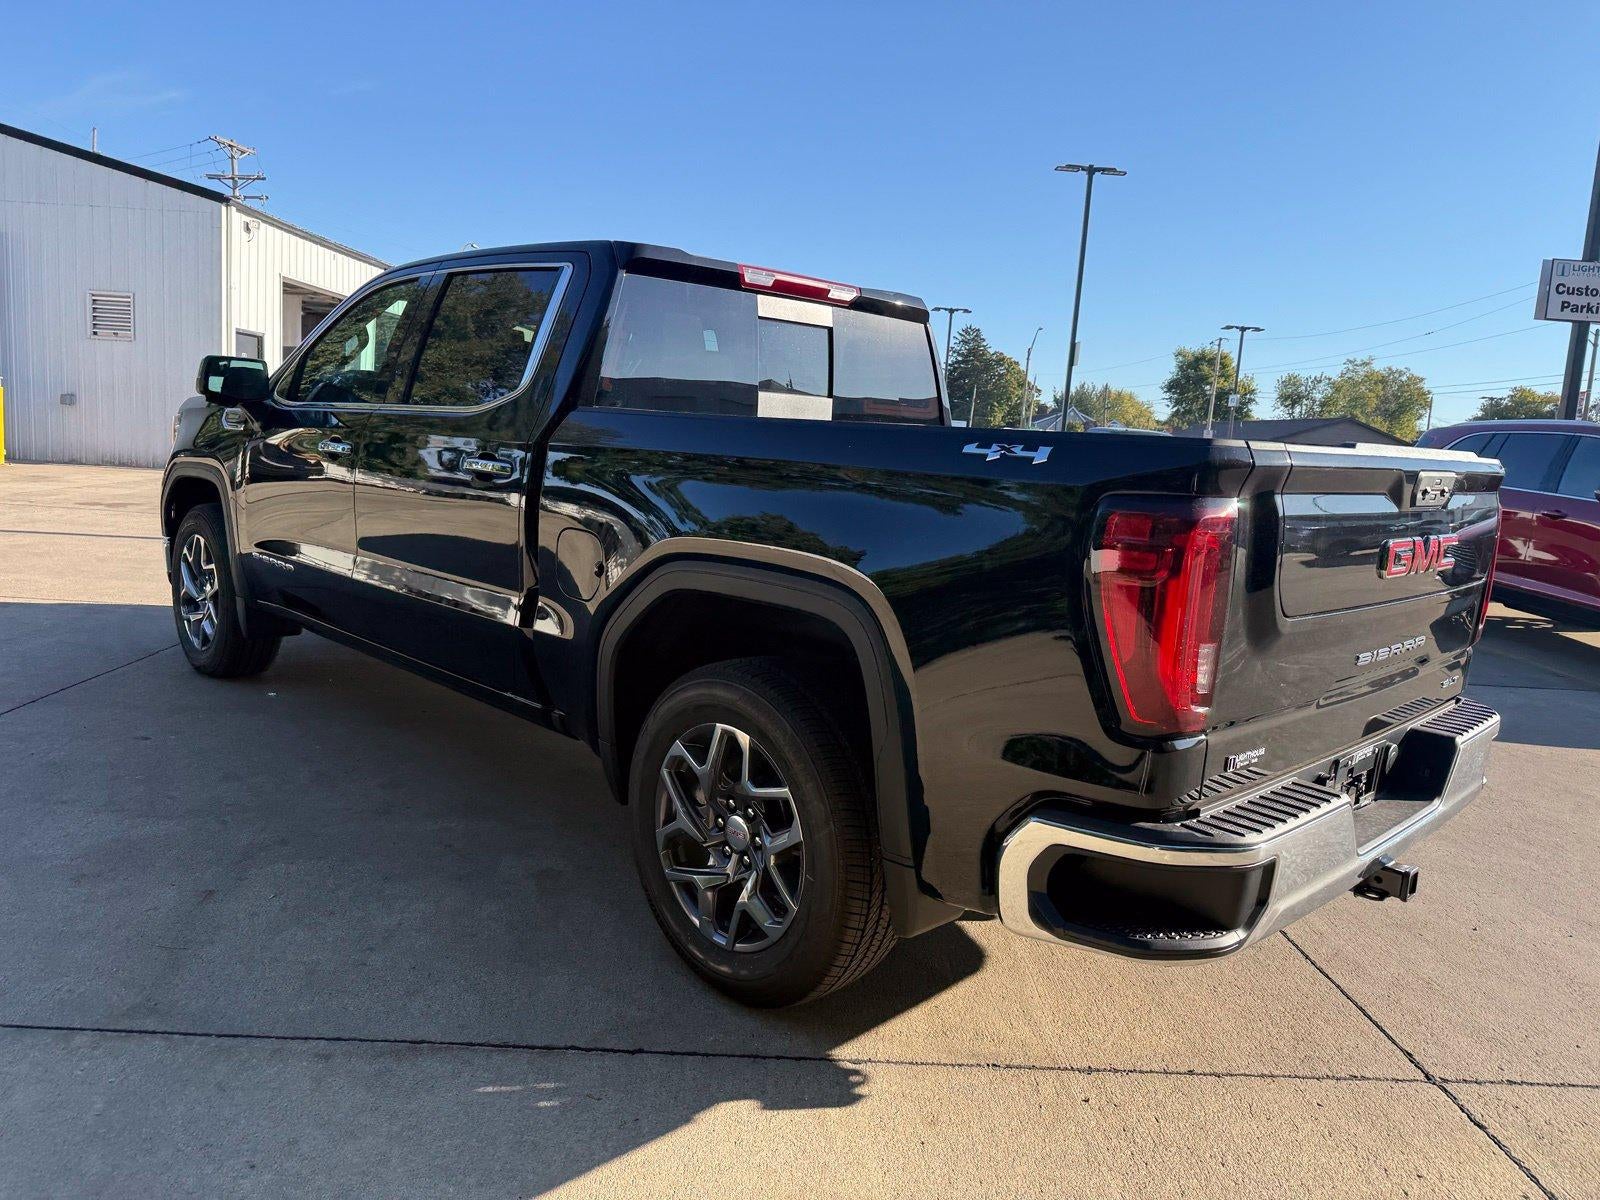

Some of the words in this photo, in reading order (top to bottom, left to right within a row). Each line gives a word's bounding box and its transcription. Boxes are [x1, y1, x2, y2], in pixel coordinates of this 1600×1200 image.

[1555, 283, 1600, 298] Custo
[252, 552, 294, 572] SIERRA
[1380, 534, 1459, 578] GMC
[1356, 635, 1426, 666] SIERRA
